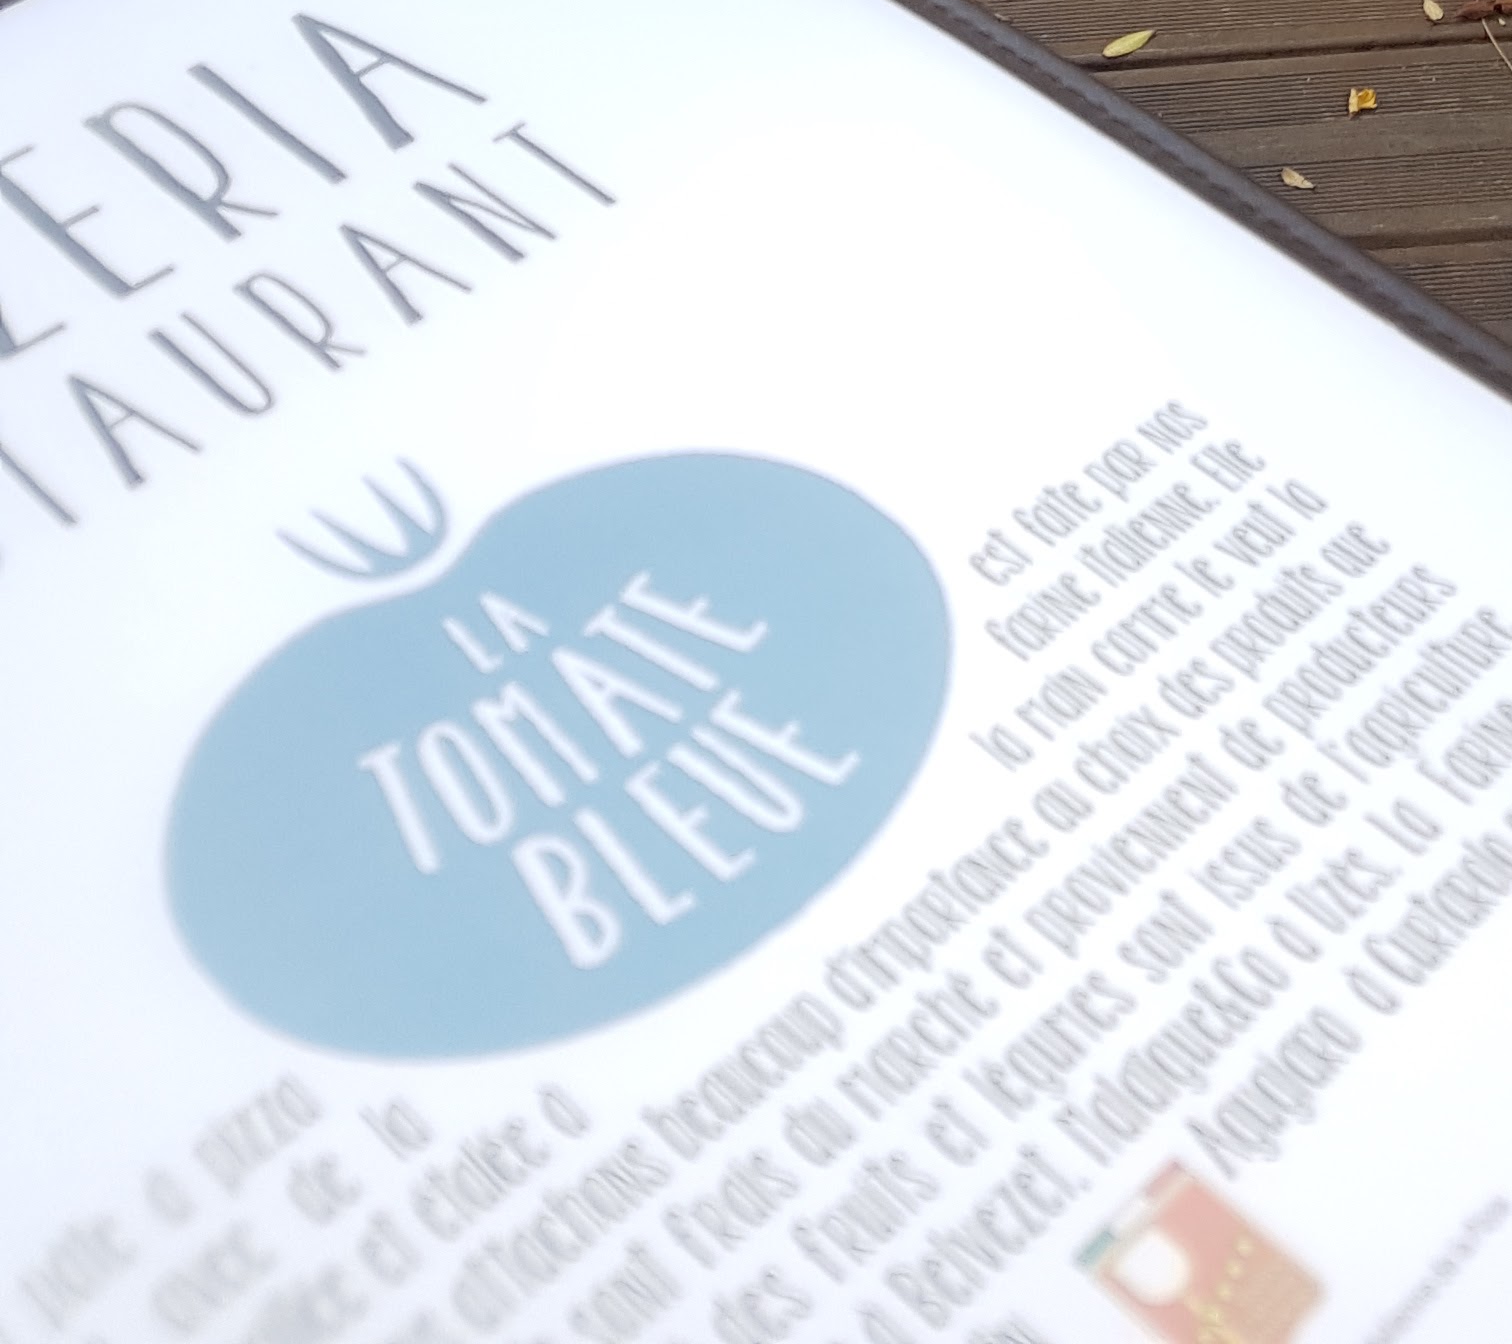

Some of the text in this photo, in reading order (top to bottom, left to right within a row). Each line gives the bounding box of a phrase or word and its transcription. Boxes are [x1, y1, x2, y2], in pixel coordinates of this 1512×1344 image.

[0, 13, 488, 358] ERIA
[360, 573, 767, 874] TOMATE
[444, 593, 548, 673] LA
[513, 692, 859, 968] BLEUE
